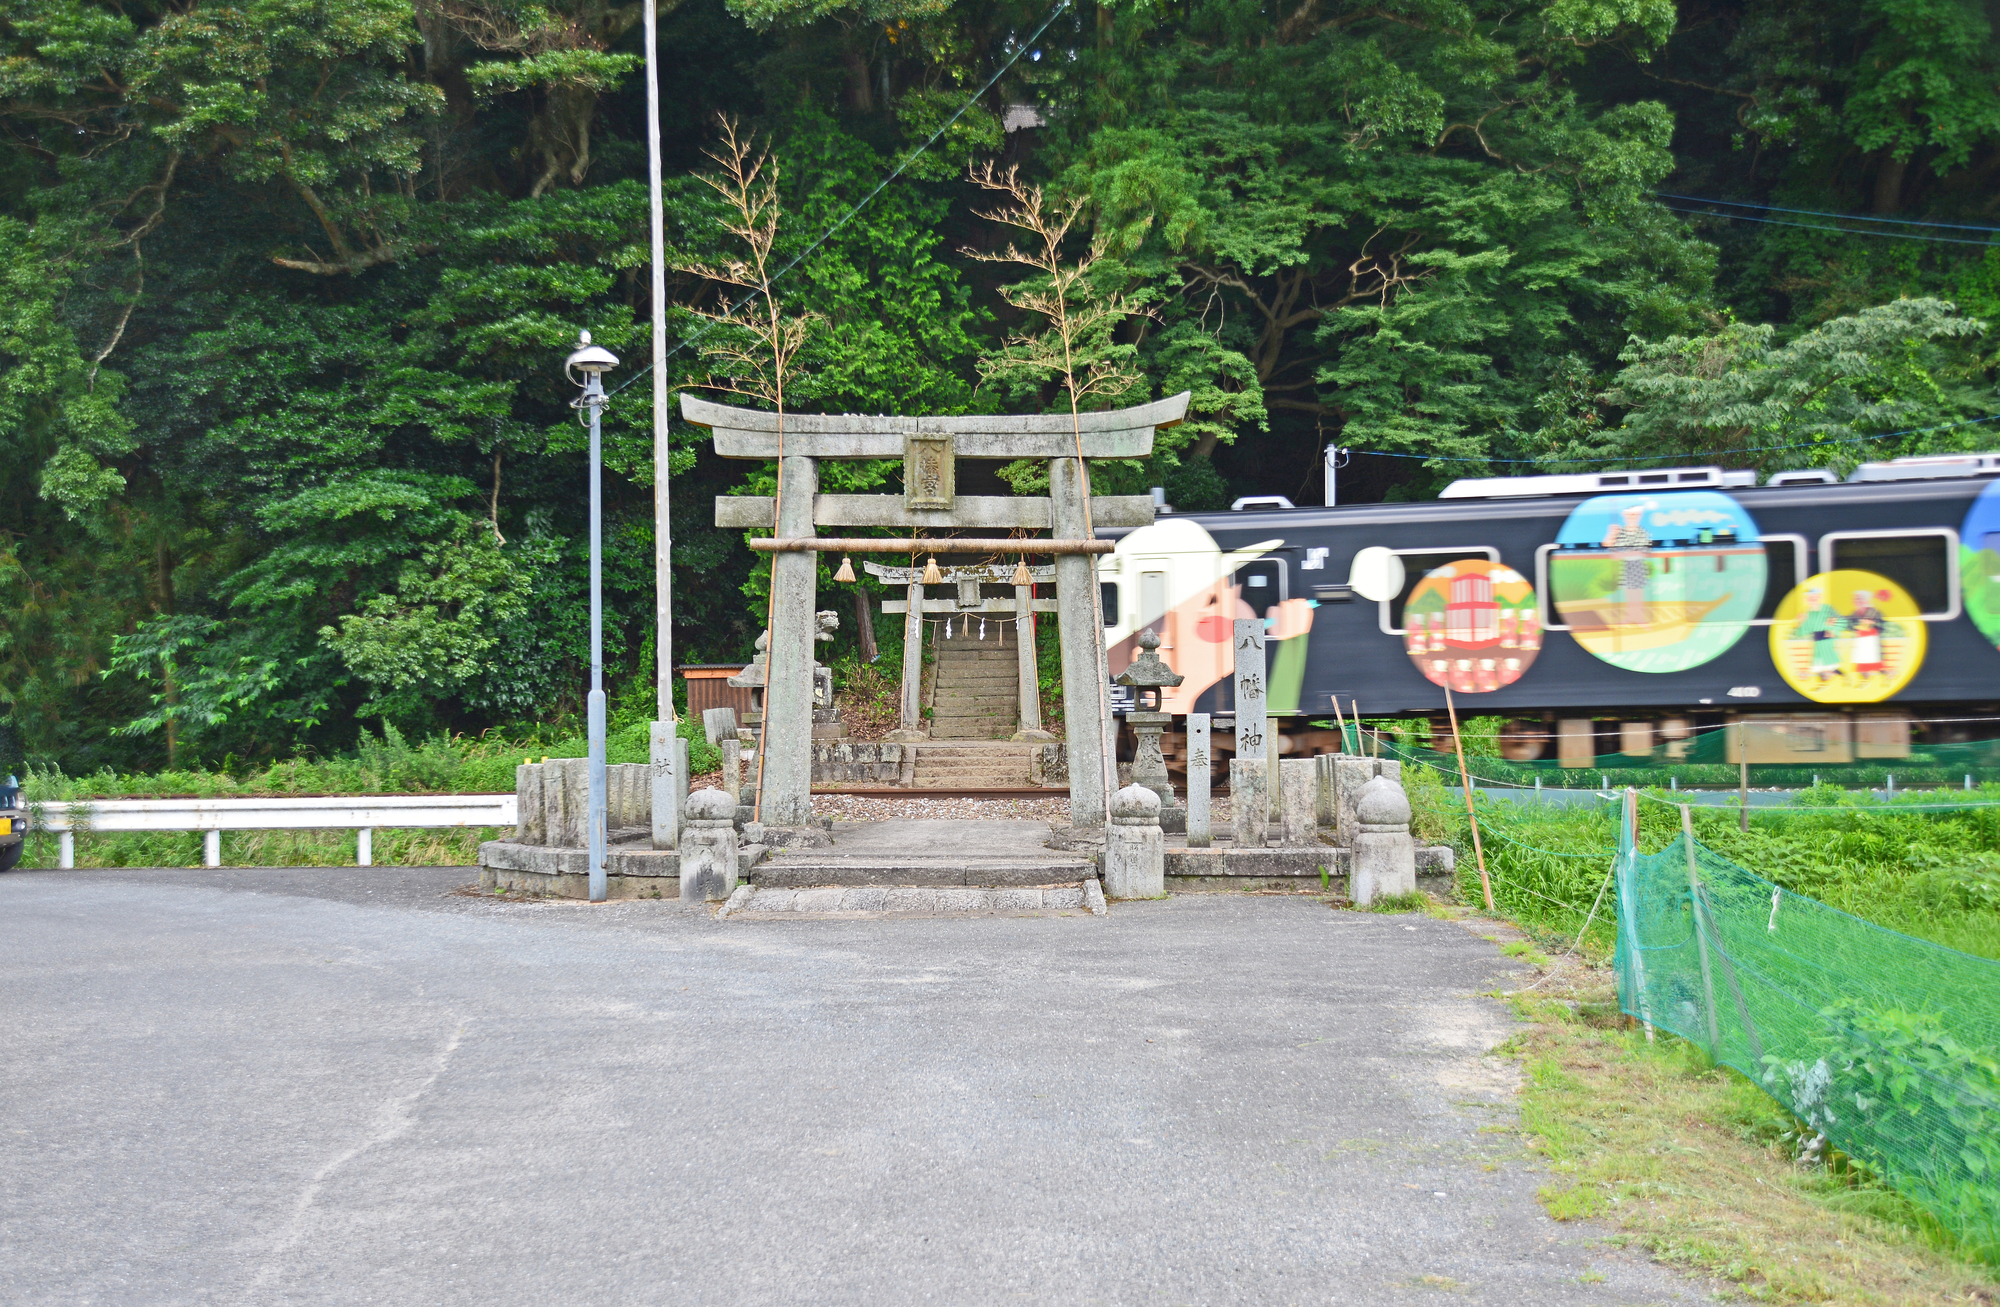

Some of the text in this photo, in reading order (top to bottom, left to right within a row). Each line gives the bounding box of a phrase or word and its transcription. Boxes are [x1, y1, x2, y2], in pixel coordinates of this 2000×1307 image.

[1238, 635, 1265, 754] 八幡神
[652, 758, 673, 778] 献
[1190, 747, 1209, 770] 奉
